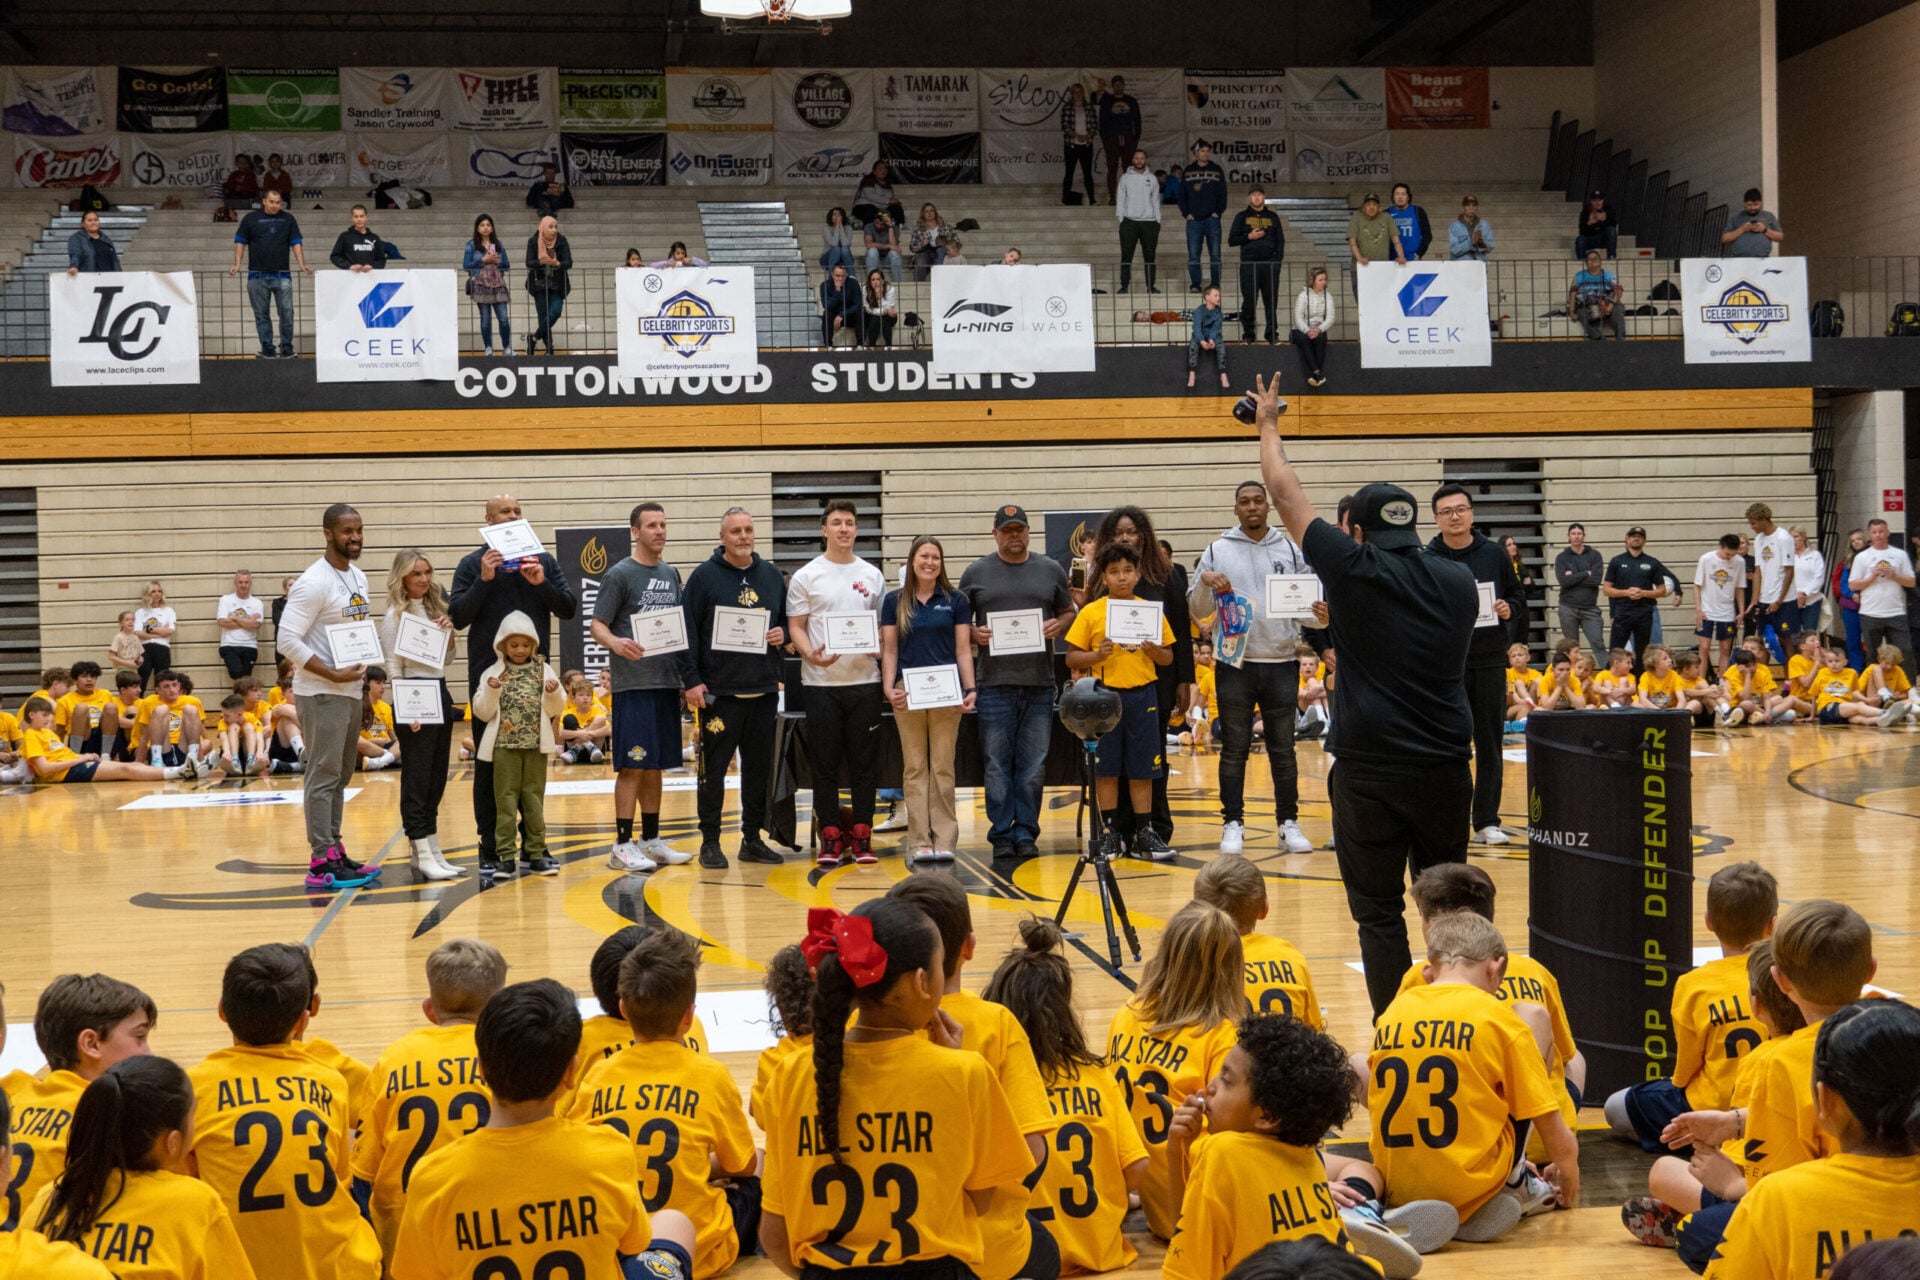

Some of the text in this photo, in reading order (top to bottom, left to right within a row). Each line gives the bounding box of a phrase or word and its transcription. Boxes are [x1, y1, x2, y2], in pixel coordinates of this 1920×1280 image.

[131, 77, 213, 95] Go Colts!
[903, 75, 969, 92] TAMARAK
[1411, 73, 1464, 86] Beans
[562, 85, 657, 104] PRECISION
[801, 88, 845, 100] VILLAGE
[1210, 84, 1283, 94] PRINCETON
[1430, 86, 1444, 98] &
[1210, 99, 1284, 110] MORTGAGE
[1411, 94, 1464, 108] Brews
[347, 107, 441, 120] Sandler Training
[805, 107, 842, 120] BAKER
[354, 119, 434, 130] Jason Caywood
[591, 149, 616, 159] RAY
[1212, 138, 1286, 155] OnGuard
[280, 152, 304, 166] LACK
[591, 156, 663, 170] FASTENERS
[694, 153, 773, 169] OnGuard
[986, 153, 1022, 165] Steven
[1228, 154, 1273, 162] ALARM
[710, 168, 759, 177] ALARM
[1229, 169, 1277, 184] Colts!
[1326, 163, 1389, 177] EXPERTS
[1705, 307, 1785, 320] CELEBRITY SPORTS
[78, 286, 171, 361] LC
[643, 319, 730, 332] CELEBRITY SPORTS
[943, 321, 1084, 334] LI-NING WADE
[1385, 326, 1461, 344] CEEK
[344, 338, 426, 357] CEEK
[1398, 347, 1455, 356] www.ceek.com
[85, 366, 165, 375] www.laceclips.com
[357, 360, 420, 370] www.ceek.com
[646, 363, 730, 372] @celebritysportsacademy
[454, 364, 773, 398] COTTONWOOD
[1643, 725, 1668, 918] DEFENDER
[1644, 938, 1668, 988] UP
[1244, 960, 1297, 984] STAR
[1708, 994, 1751, 1028] ALL
[1373, 1020, 1475, 1052] ALL STAR
[1645, 1008, 1668, 1082] POP
[1135, 1035, 1189, 1073] STAR
[386, 1056, 487, 1100] ALL STA
[217, 1076, 333, 1117] ALL STAR
[591, 1083, 700, 1120] ALL STAR
[1375, 1055, 1460, 1150] 23
[9, 1106, 73, 1142] STAR
[856, 1111, 934, 1153] STAR
[233, 1108, 338, 1214] 23
[1743, 1167, 1770, 1178] EEK
[811, 1161, 921, 1267] 23
[1268, 1185, 1317, 1235] ALL
[455, 1195, 600, 1252] ALL STAR
